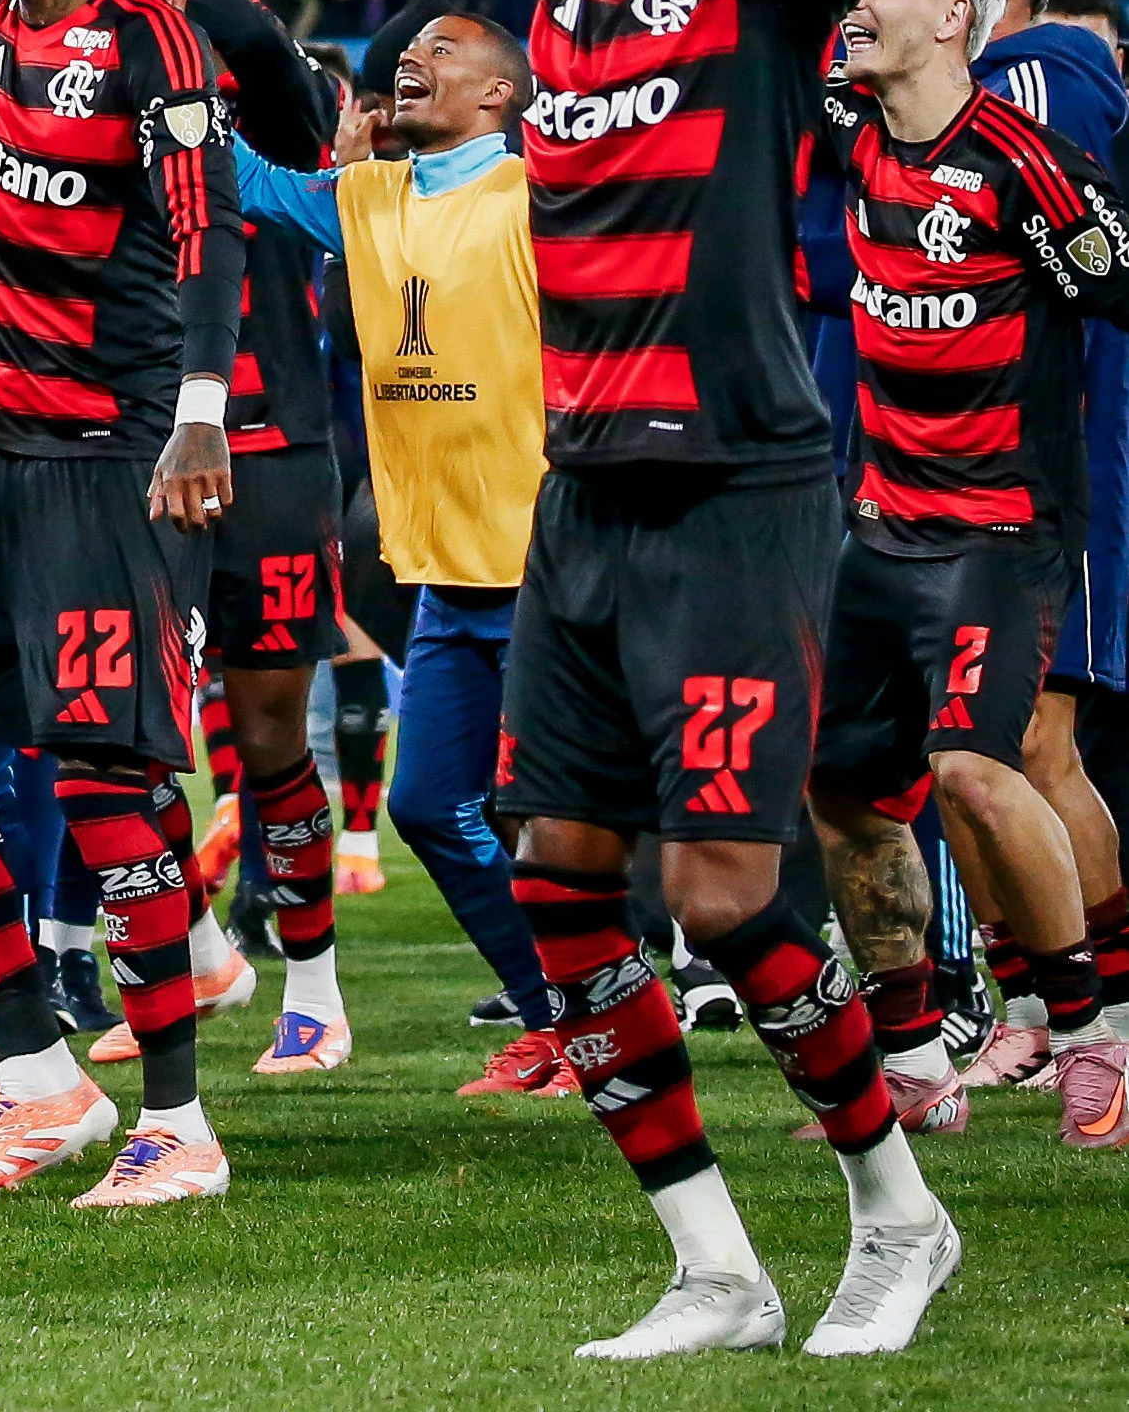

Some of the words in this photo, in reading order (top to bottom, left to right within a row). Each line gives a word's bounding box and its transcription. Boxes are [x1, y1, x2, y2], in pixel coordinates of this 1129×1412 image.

[948, 169, 984, 193] BRB
[1022, 214, 1079, 299] Shopee
[373, 383, 476, 401] LIBERTADORES
[261, 554, 316, 620] 52
[57, 609, 133, 688] 22
[947, 626, 990, 695] 2
[682, 676, 776, 770] 27
[103, 885, 160, 901] DELIVERY
